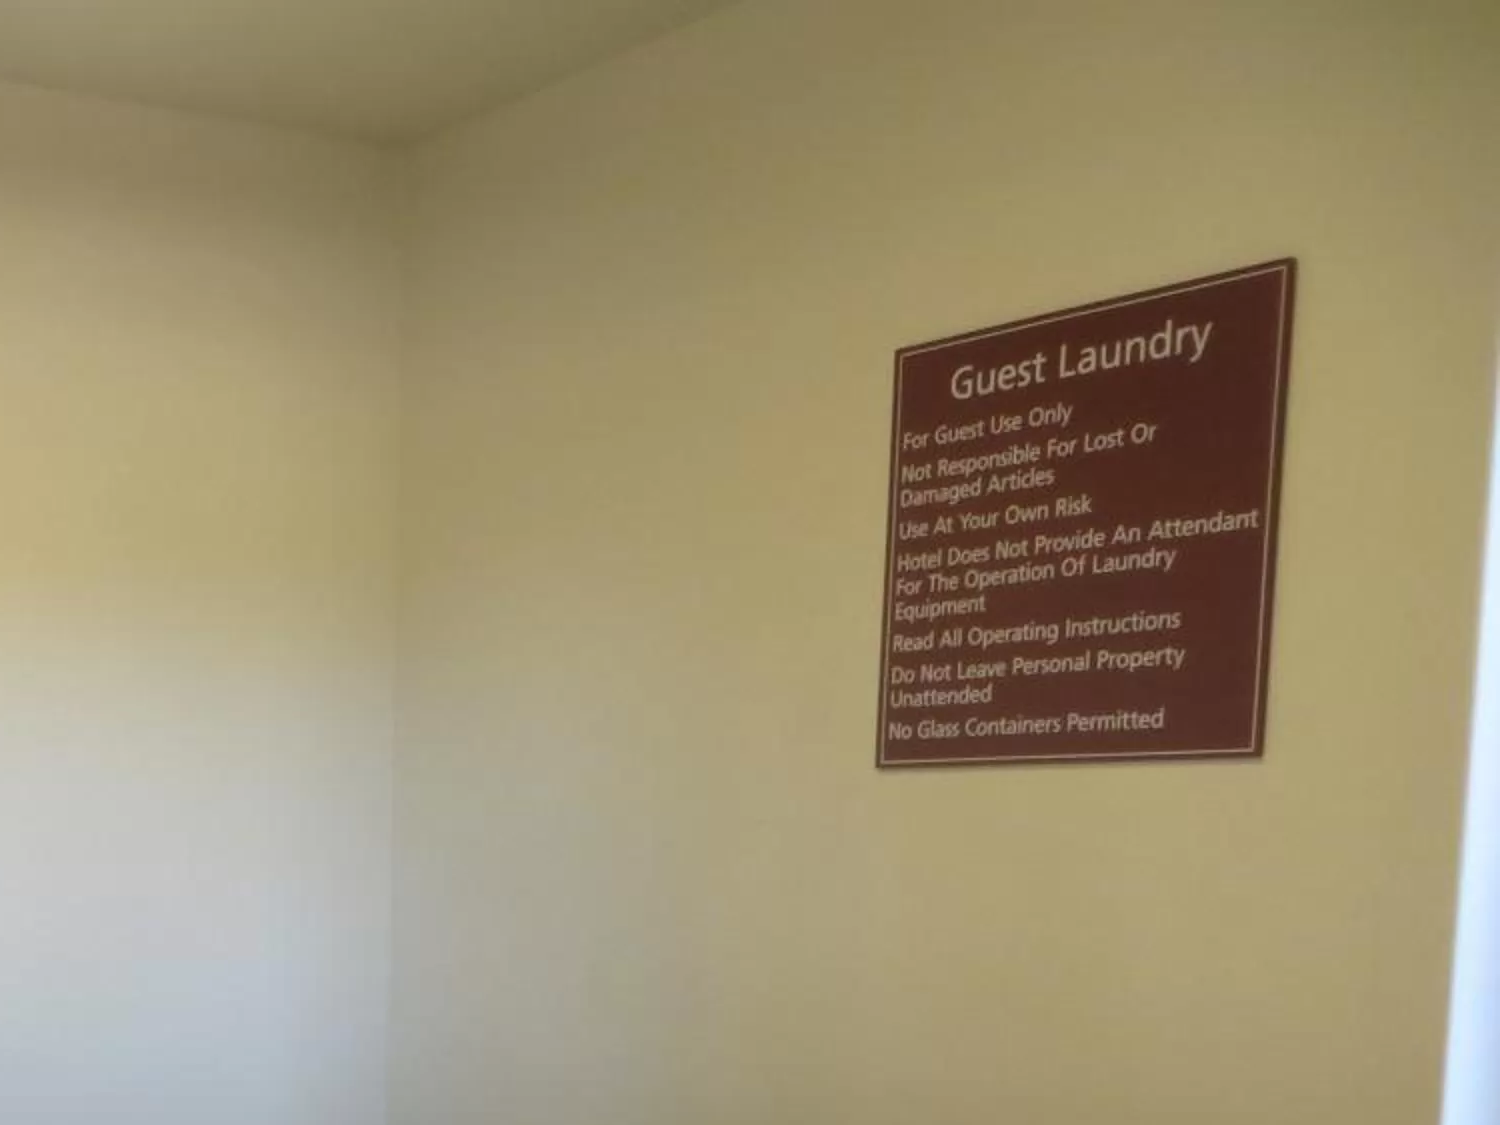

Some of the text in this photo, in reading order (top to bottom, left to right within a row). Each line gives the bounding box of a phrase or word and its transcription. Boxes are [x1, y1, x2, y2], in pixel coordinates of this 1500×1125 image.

[951, 319, 1213, 399] Guest Laundry
[903, 402, 1073, 449] For Guest Use Only
[901, 423, 1158, 483] Not Responsible For Lost Or
[900, 467, 1055, 507] Damaged Articles
[900, 493, 1092, 540] Use At Your Own Risk
[897, 508, 1259, 572] Hotel Does Not Provide An Attendant
[896, 547, 1177, 595] For The Operation Of Laundry
[893, 610, 1181, 652] Read All Operating Instructions
[895, 596, 987, 624] Equipment
[891, 647, 1186, 684] Do Not Leave Personal Property
[891, 683, 993, 709] Unattended
[888, 706, 1164, 740] No Glass Containers Permitted
